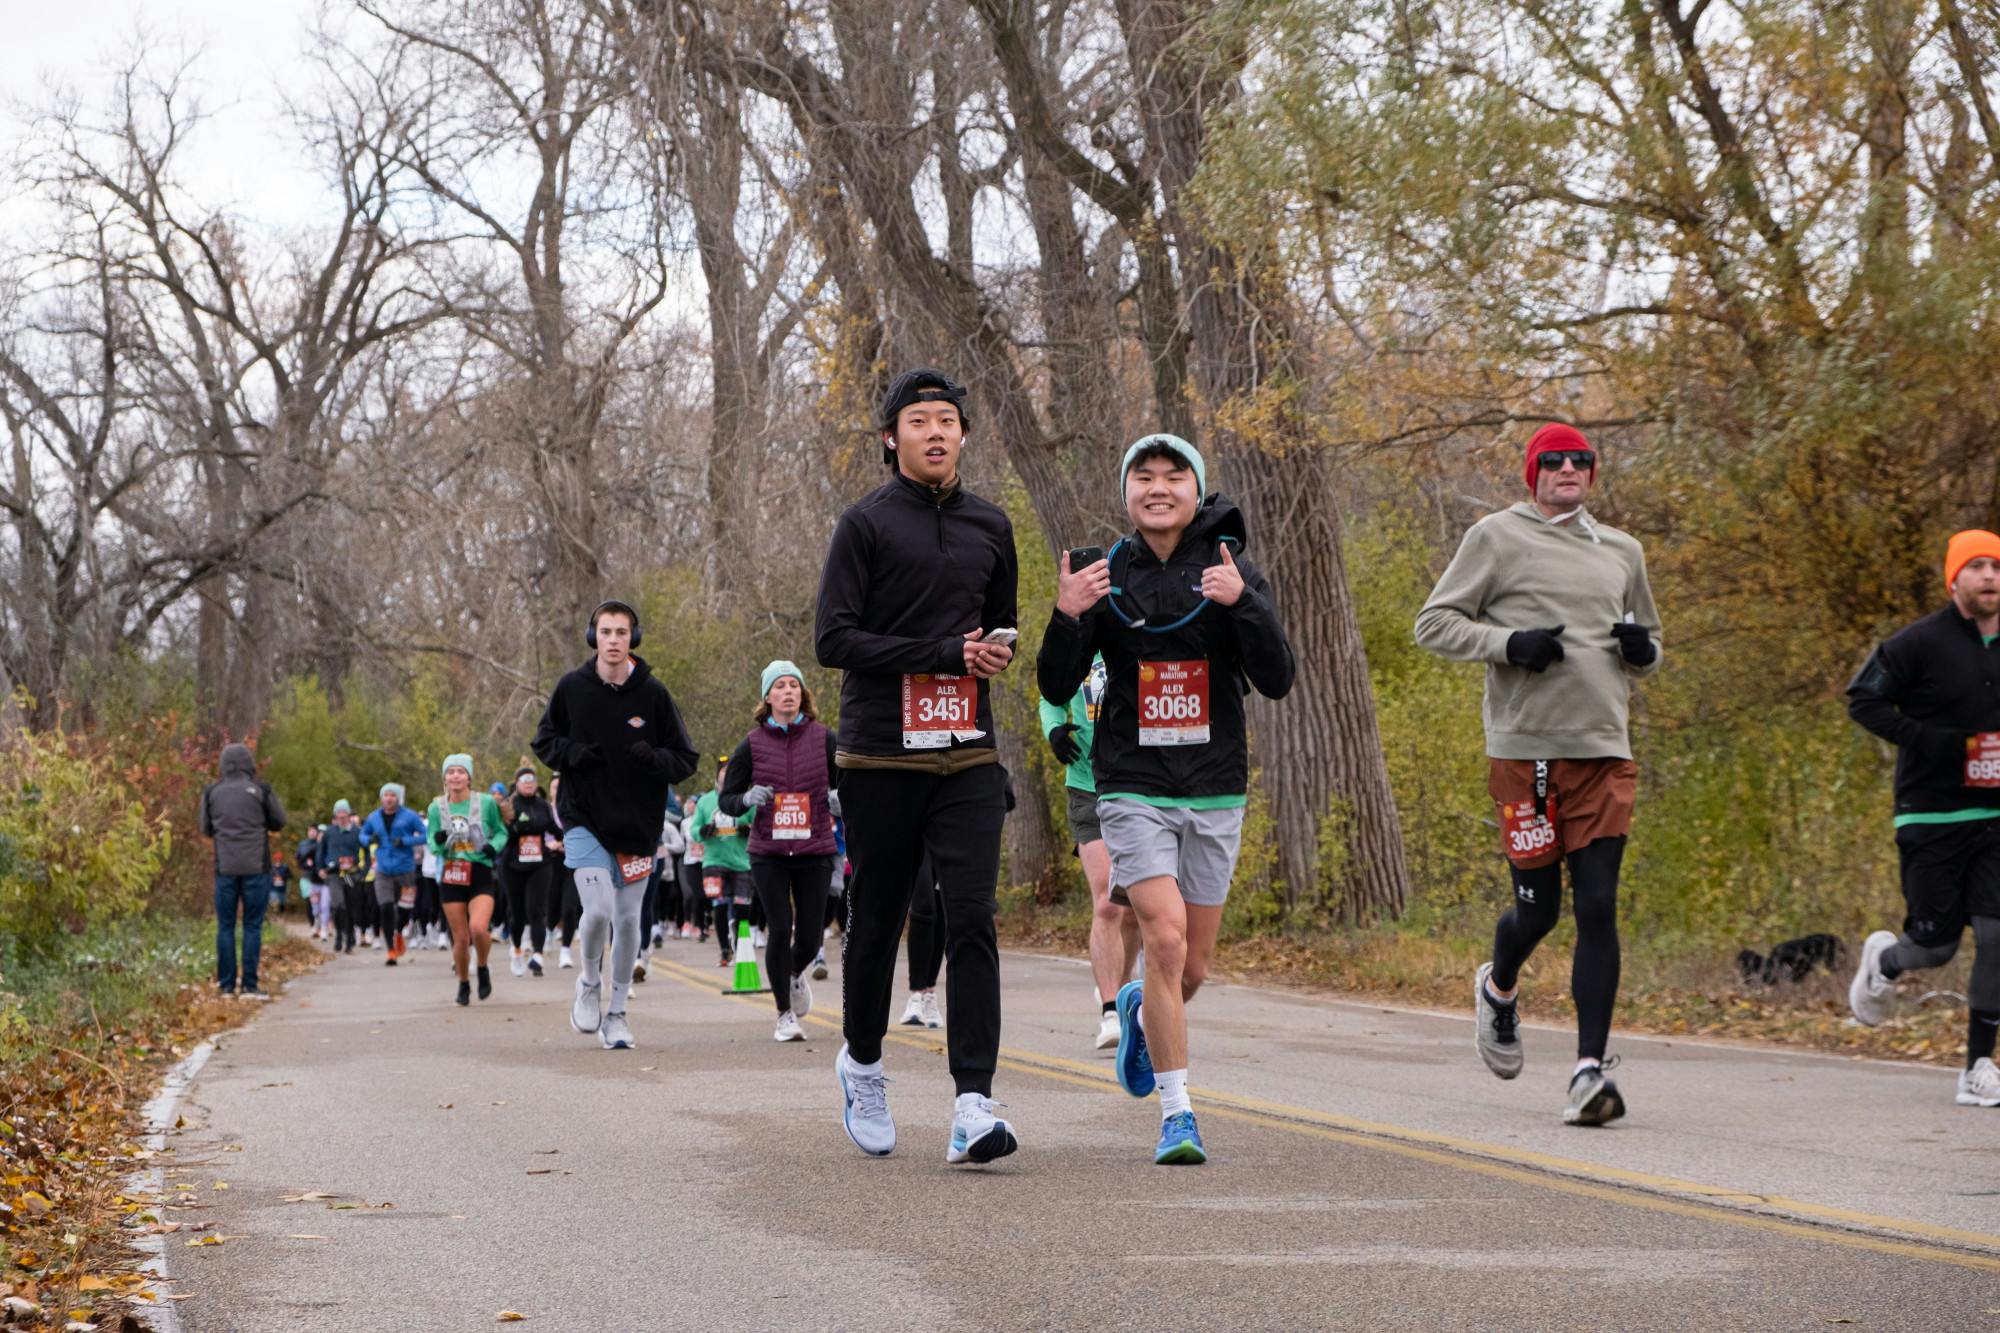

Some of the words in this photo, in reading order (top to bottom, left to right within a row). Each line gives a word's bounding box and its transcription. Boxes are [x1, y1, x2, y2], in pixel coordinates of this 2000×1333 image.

[937, 685, 957, 695] ALEX
[1162, 684, 1184, 694] ALEX
[918, 697, 969, 722] 3451
[1144, 694, 1201, 720] 3068
[775, 811, 806, 825] 6619
[1509, 822, 1556, 851] 3095
[623, 855, 653, 878] 5652
